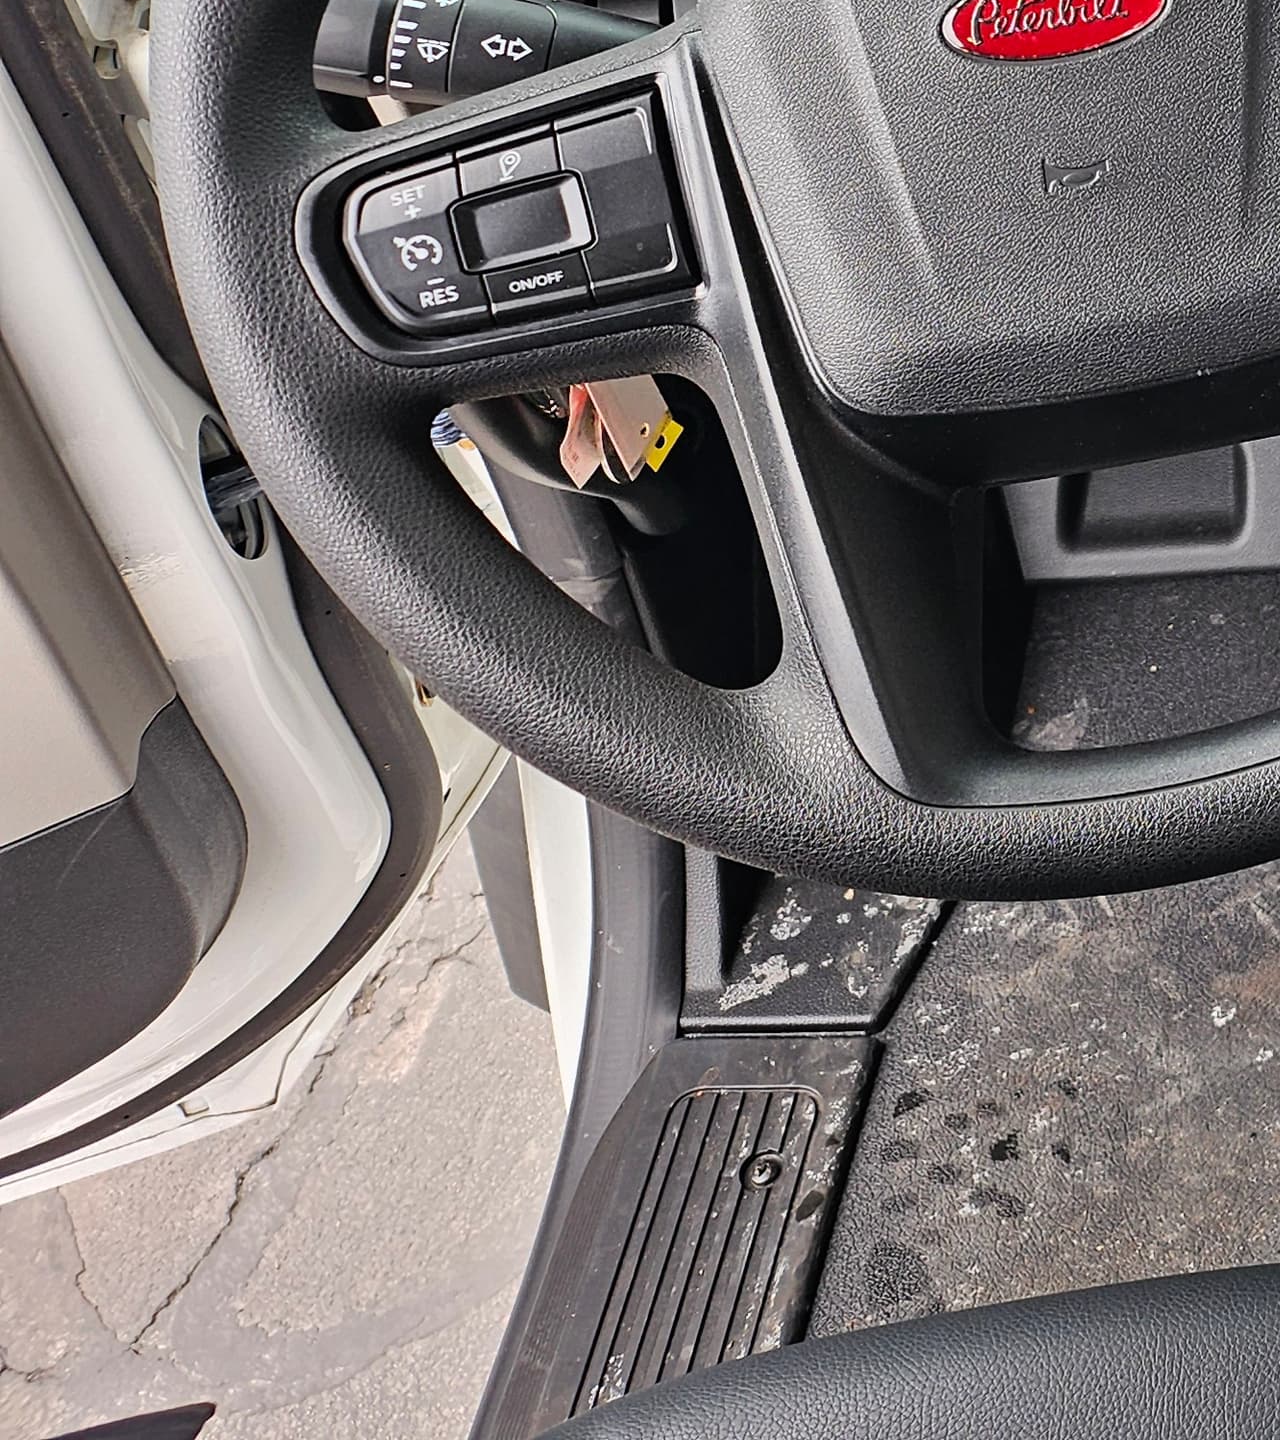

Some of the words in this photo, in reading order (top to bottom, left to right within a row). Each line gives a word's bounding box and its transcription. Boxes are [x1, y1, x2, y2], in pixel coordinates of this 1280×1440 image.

[390, 184, 426, 207] SET
[508, 270, 565, 293] ON/OFF
[418, 285, 460, 308] RES
